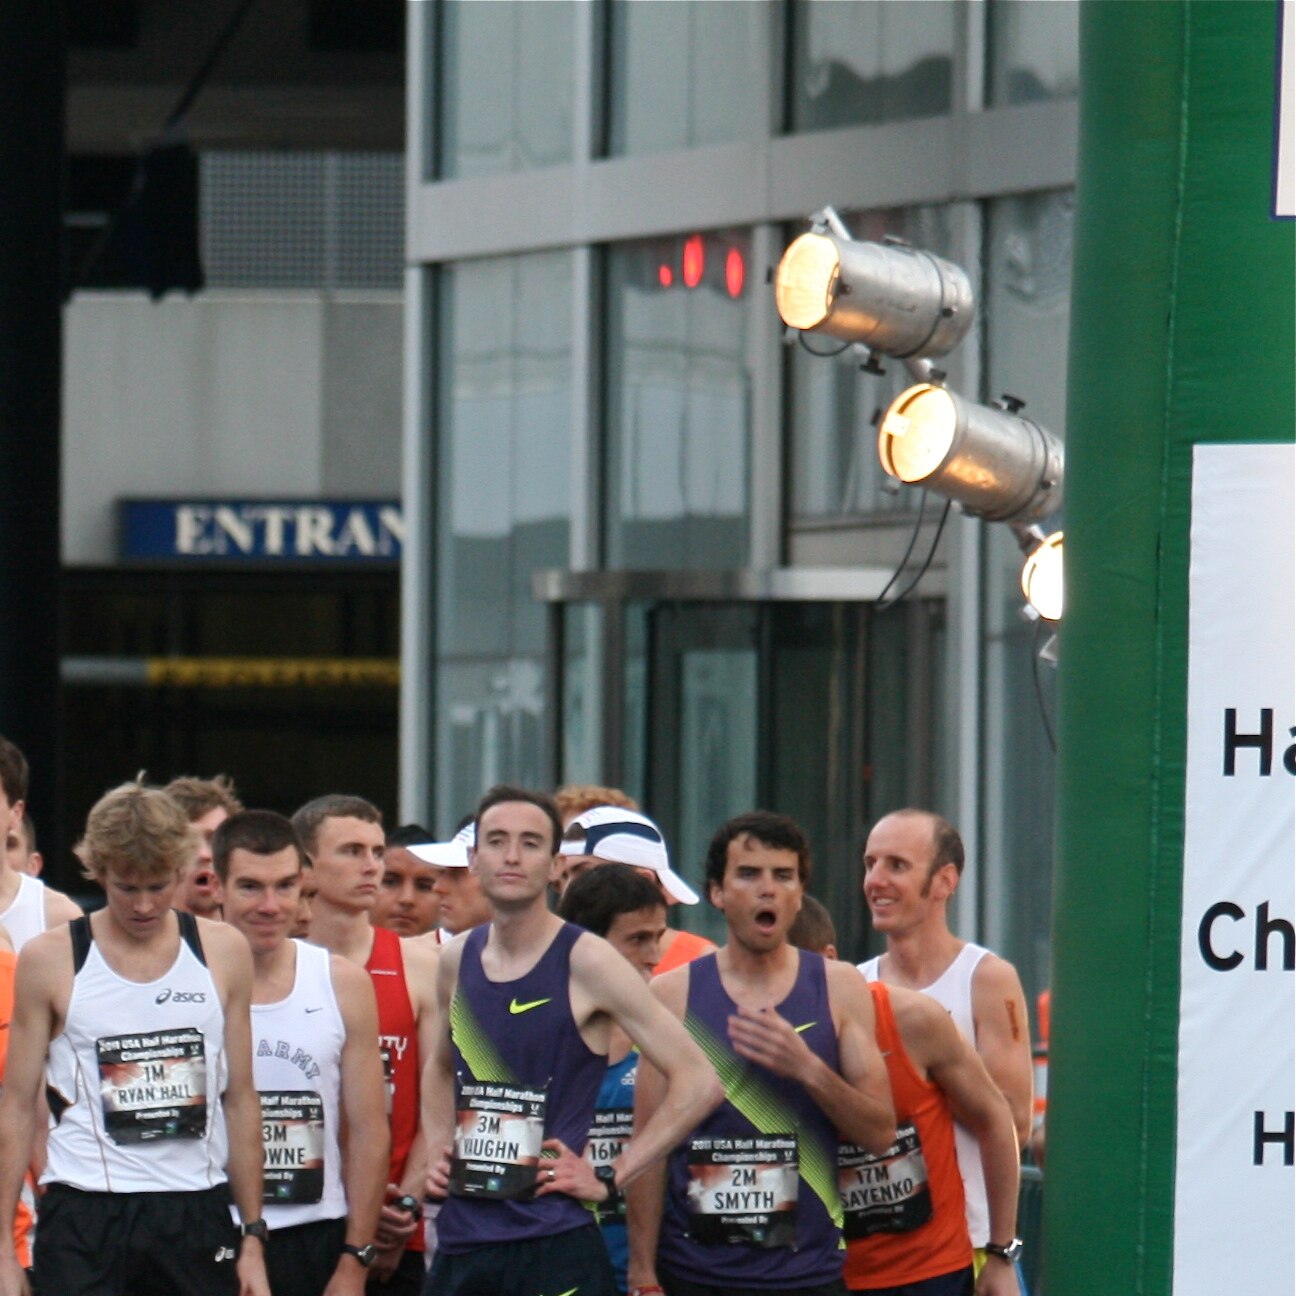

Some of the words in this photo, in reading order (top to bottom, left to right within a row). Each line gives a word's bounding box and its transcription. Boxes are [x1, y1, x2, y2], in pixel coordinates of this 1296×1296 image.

[175, 506, 406, 555] ENTRAN
[172, 991, 206, 1003] asics
[121, 1039, 141, 1049] USA
[142, 1036, 160, 1047] Half
[161, 1033, 203, 1044] Marathon
[121, 1047, 184, 1061] Championships
[256, 1039, 320, 1080] ARMY
[144, 1064, 164, 1082] 1M
[118, 1087, 155, 1104] RYAN
[161, 1084, 191, 1100] HALL
[281, 1096, 321, 1106] Marathon
[486, 1086, 503, 1097] Half
[504, 1088, 545, 1102] Marathon
[263, 1125, 287, 1142] 3M
[477, 1116, 500, 1134] 3M
[590, 1142, 622, 1160] 16M
[692, 1140, 712, 1150] 2011
[713, 1140, 733, 1150] USA
[734, 1139, 754, 1150] Half
[756, 1138, 796, 1150] Marathon
[712, 1152, 777, 1164] Championships
[731, 1169, 756, 1186] 2M
[856, 1164, 888, 1184] 17M
[714, 1192, 774, 1210] SMYTH
[841, 1178, 913, 1208] SAYENKO
